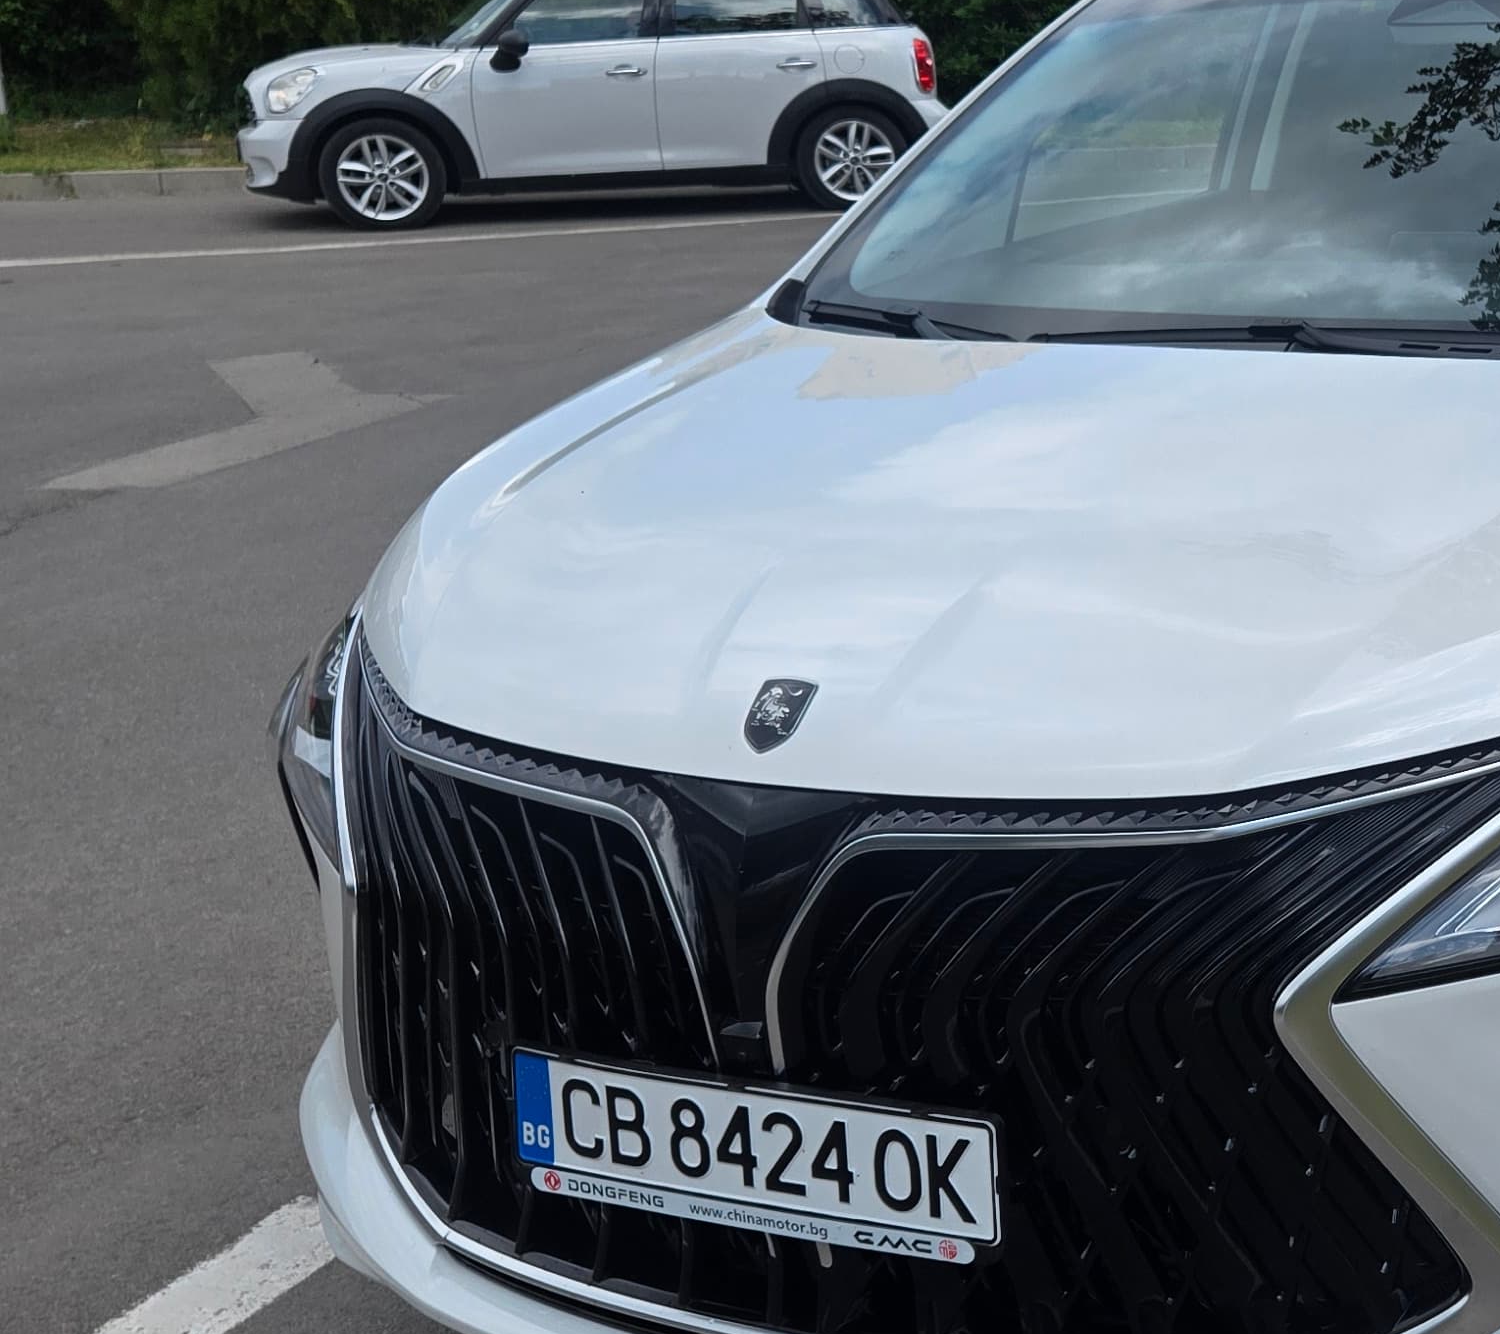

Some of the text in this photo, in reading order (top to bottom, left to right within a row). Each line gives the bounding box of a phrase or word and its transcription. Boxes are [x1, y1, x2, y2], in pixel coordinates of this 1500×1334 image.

[523, 1121, 550, 1149] BG
[561, 1078, 977, 1225] CB 8424 OK
[568, 1179, 664, 1208] DONGFENG
[689, 1204, 828, 1240] www.chinamotor.bg
